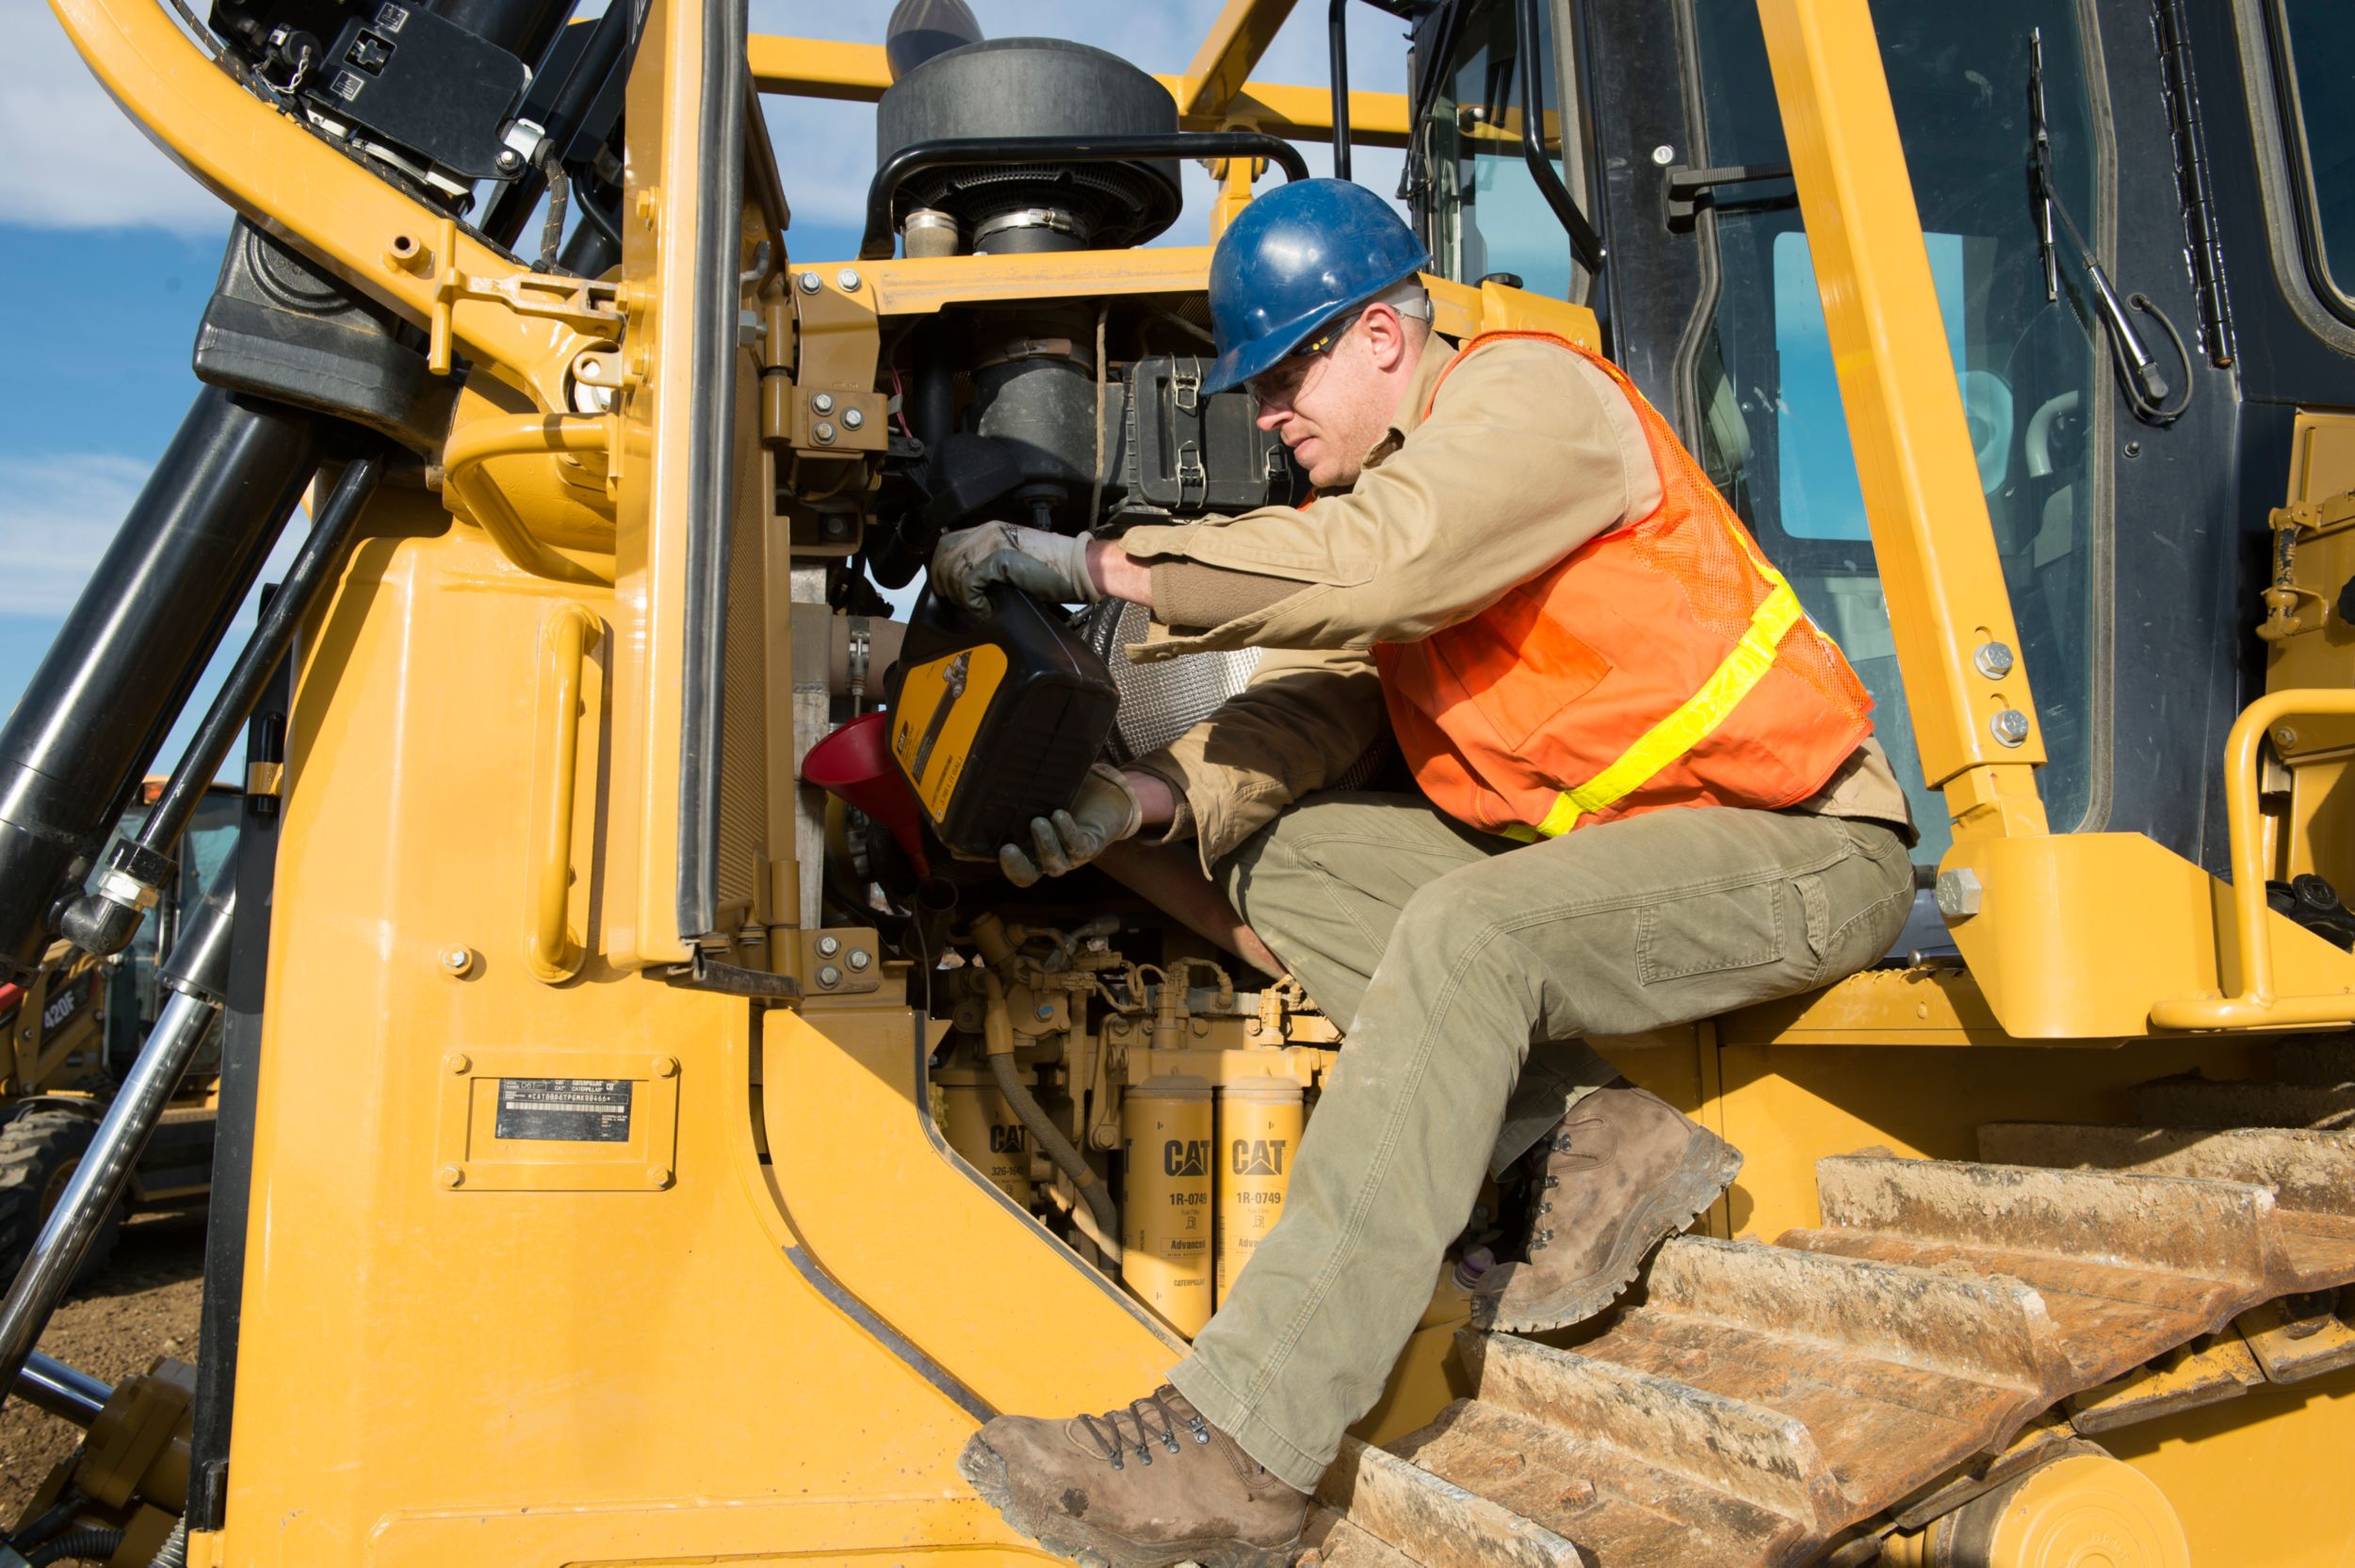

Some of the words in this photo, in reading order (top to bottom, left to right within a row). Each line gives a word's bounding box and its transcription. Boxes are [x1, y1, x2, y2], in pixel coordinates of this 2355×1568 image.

[43, 990, 75, 1029] 420F
[990, 1124, 1027, 1154] CAT
[1164, 1140, 1210, 1176] CAT
[1232, 1140, 1285, 1175] CAT
[1169, 1192, 1208, 1205] 1R-0749
[1237, 1191, 1281, 1204] 1R-0749
[1171, 1239, 1206, 1250] Advanced
